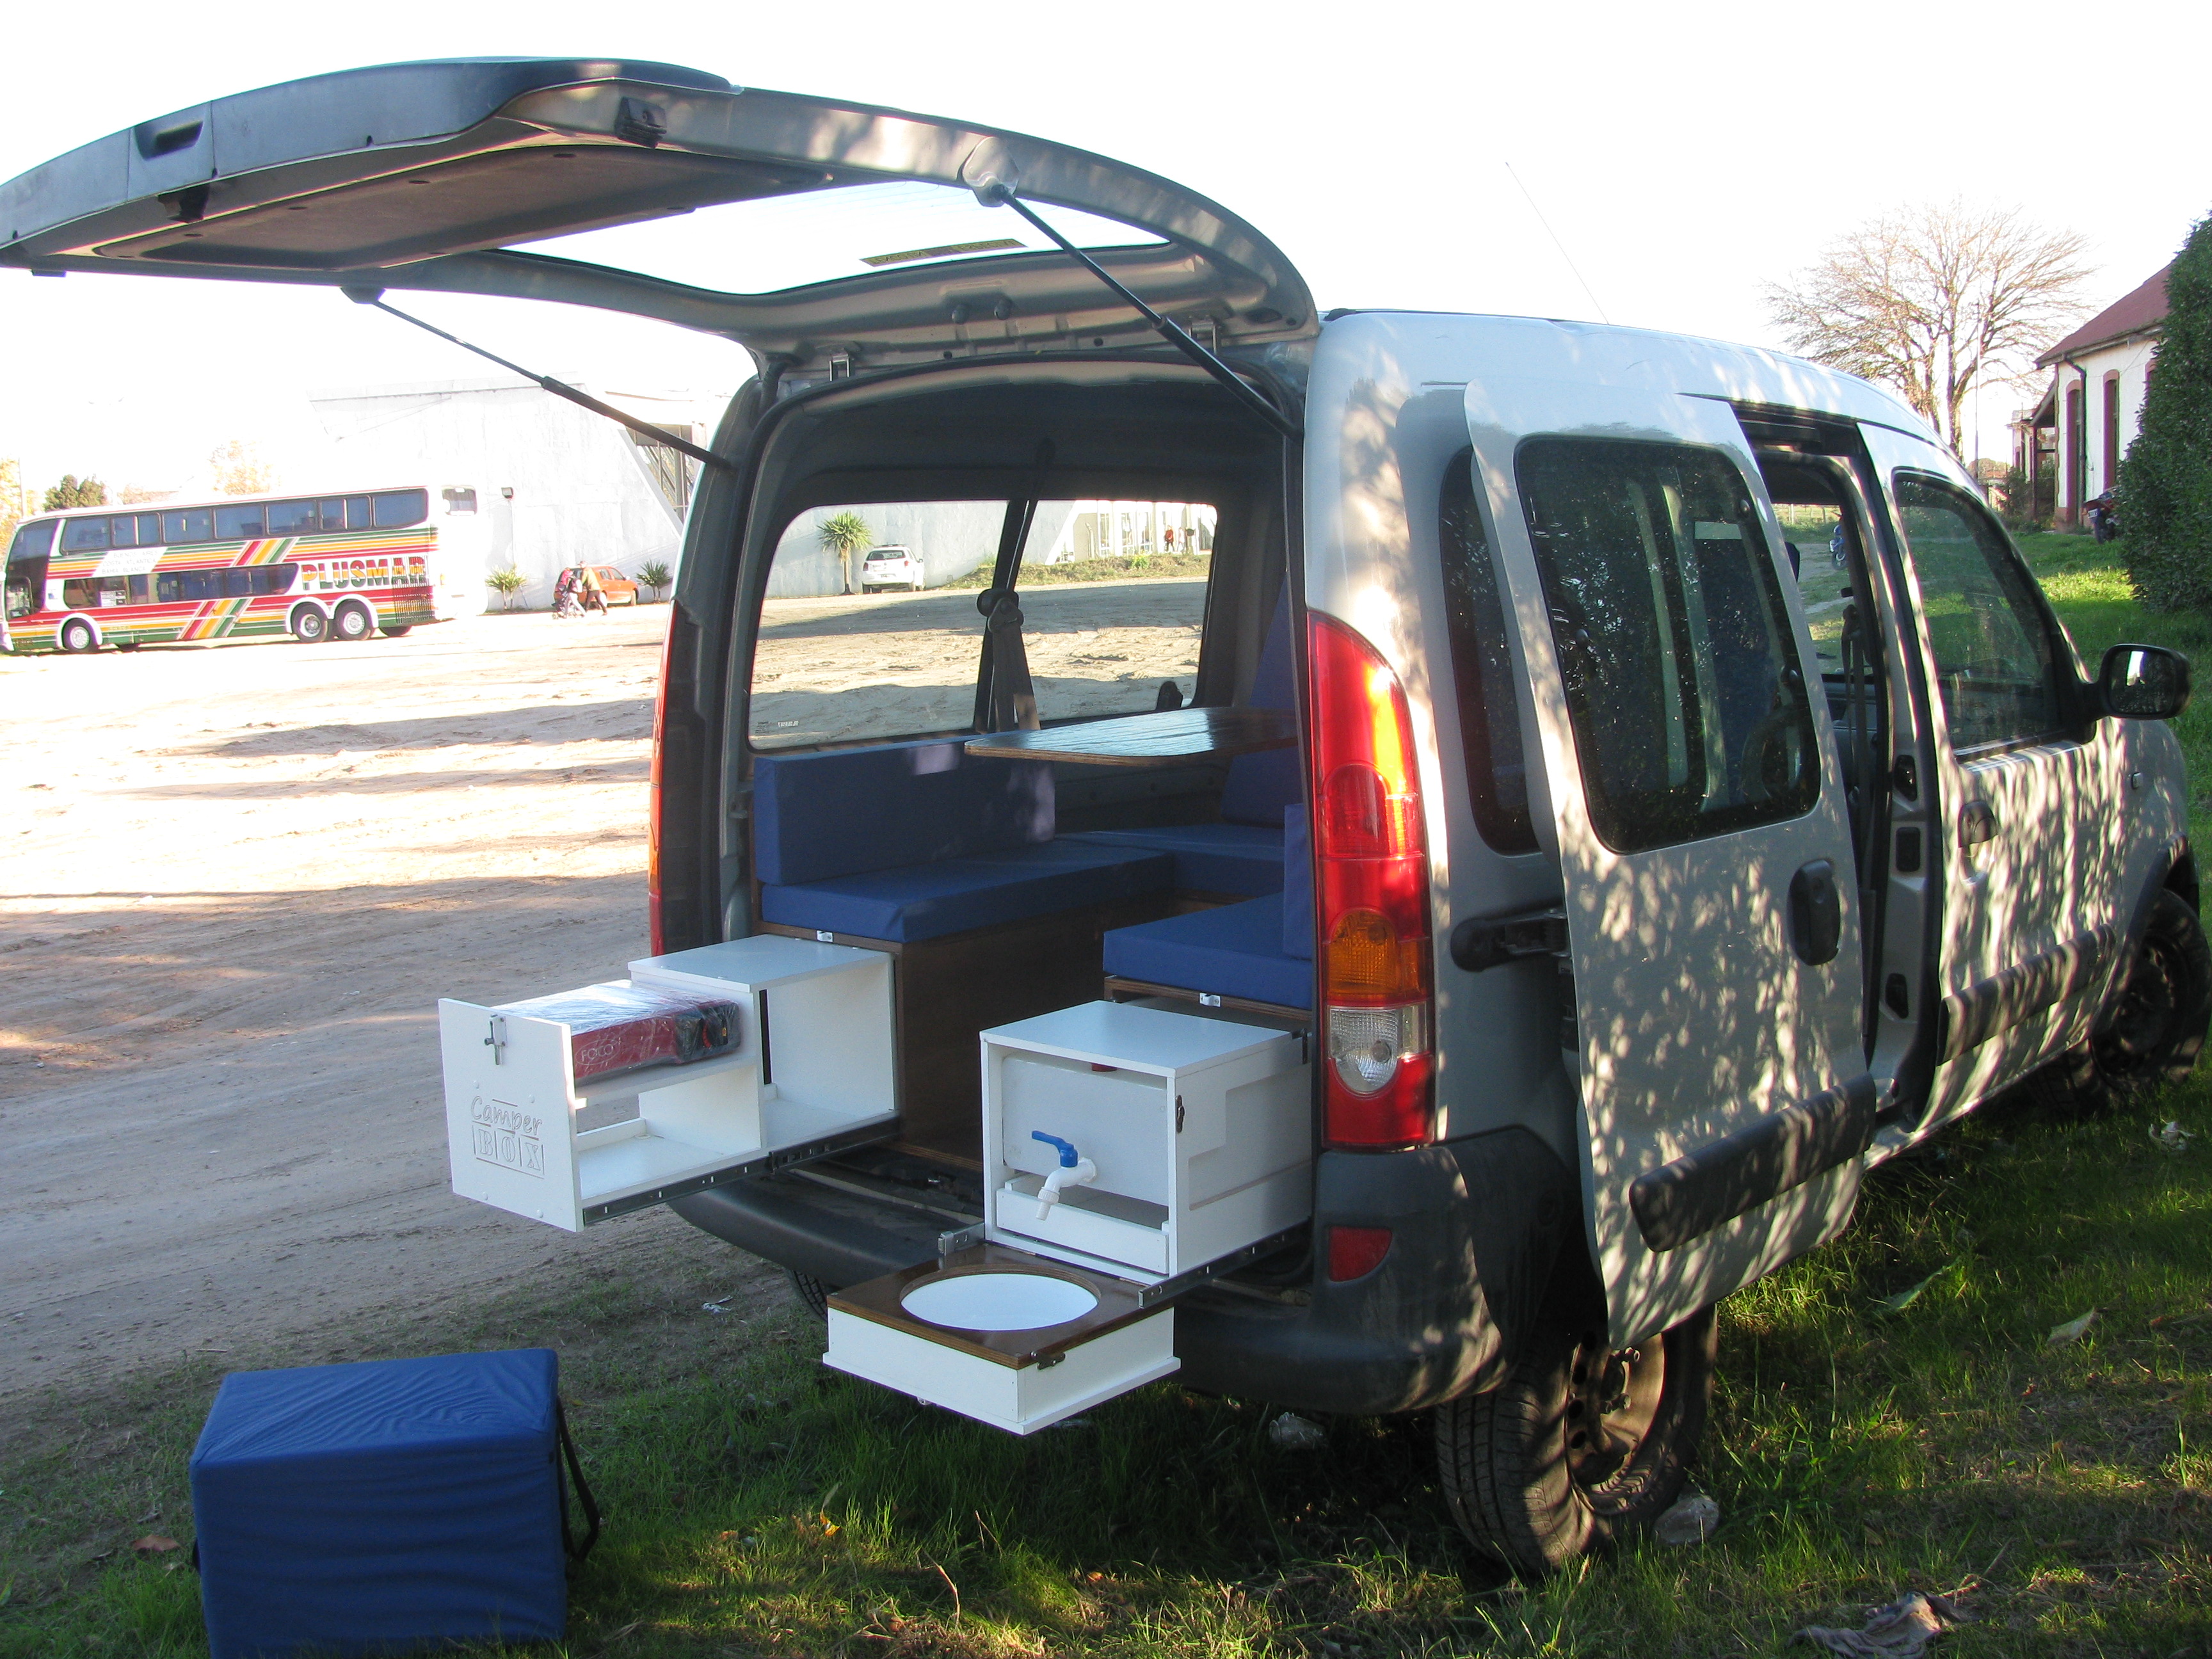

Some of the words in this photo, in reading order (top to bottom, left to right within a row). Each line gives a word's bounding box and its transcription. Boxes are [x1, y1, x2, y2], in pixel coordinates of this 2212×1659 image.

[300, 556, 427, 591] PLUSMAR
[581, 1043, 614, 1062] FOCO
[471, 1095, 543, 1139] Camper
[478, 1128, 541, 1171] BOX
